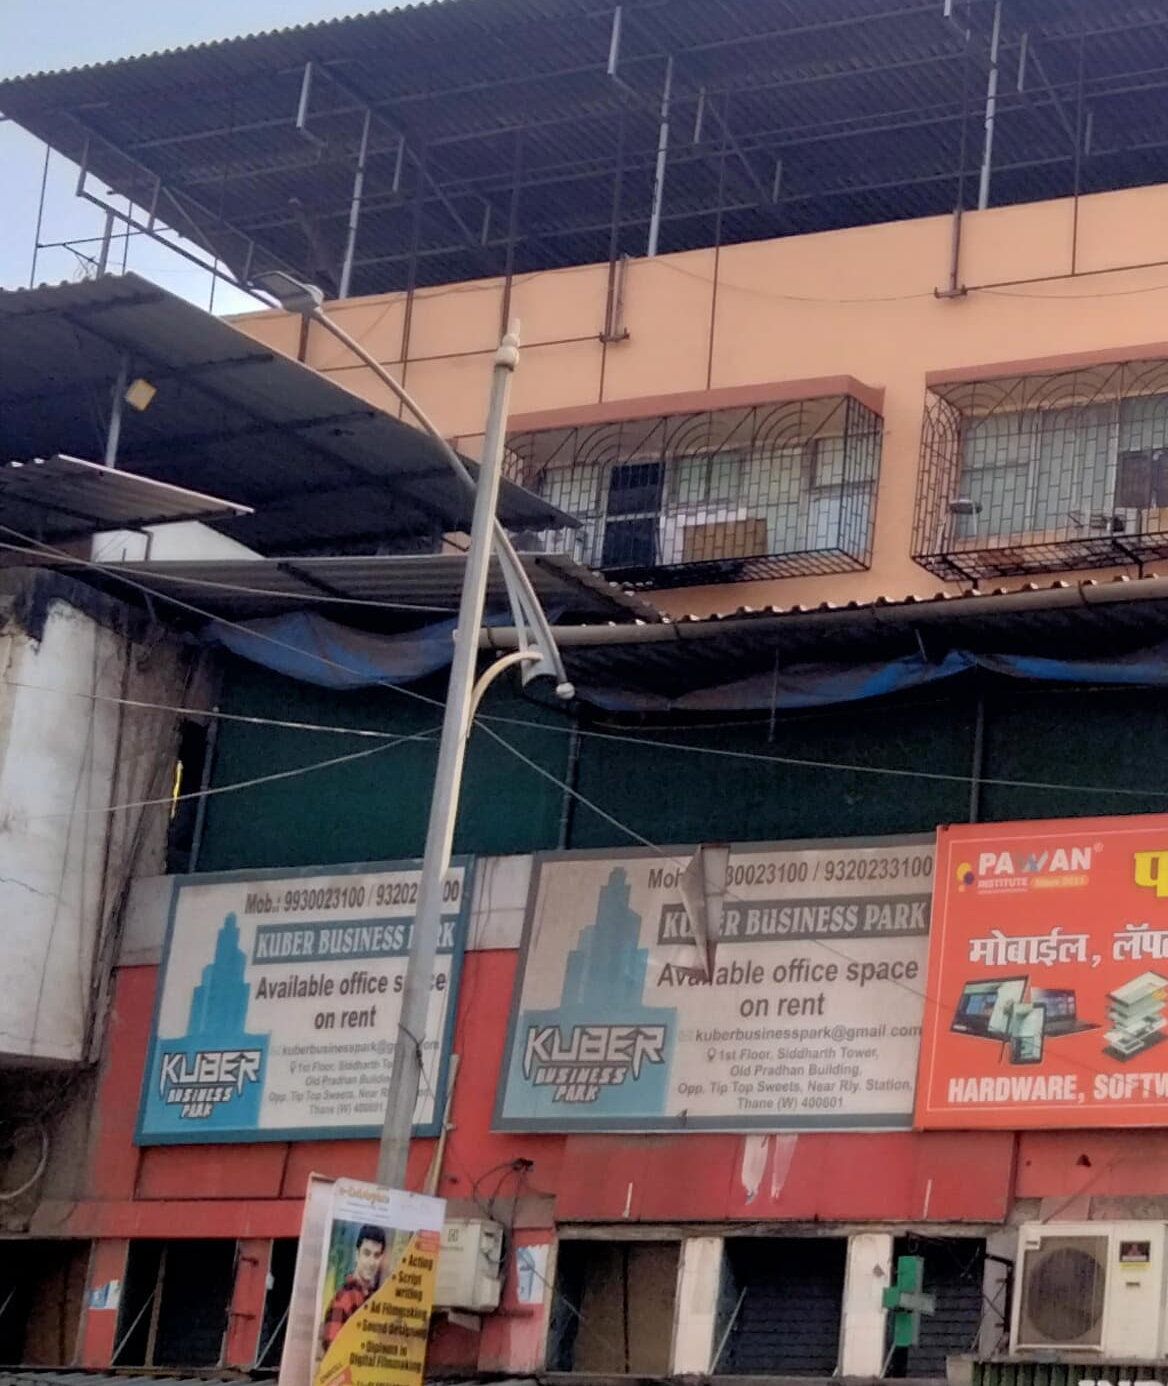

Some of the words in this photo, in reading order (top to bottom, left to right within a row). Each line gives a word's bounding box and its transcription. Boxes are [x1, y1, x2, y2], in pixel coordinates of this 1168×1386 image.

[824, 855, 934, 882] 9320233100
[979, 847, 1092, 876] PAWAN
[284, 885, 366, 912] 9930023100
[745, 903, 858, 937] BUSINESS
[864, 901, 928, 931] PARK
[256, 929, 315, 958] KUBER
[318, 925, 404, 955] BUSINESS
[255, 973, 334, 1000] Available
[339, 971, 389, 995] office
[772, 958, 838, 983] office
[846, 960, 920, 987] space
[314, 1011, 335, 1030] on
[340, 1005, 377, 1028] rent
[740, 998, 769, 1017] on
[778, 992, 826, 1016] rent
[523, 1023, 667, 1081] KUBER
[777, 1046, 837, 1060] Siddharth
[160, 1049, 262, 1098] KUBER
[532, 1066, 629, 1087] BUSINESS
[730, 1065, 751, 1077] Old
[753, 1063, 805, 1077] Pradhan
[552, 1084, 601, 1103] PARK
[710, 1082, 728, 1096] Tip
[732, 1081, 754, 1096] Top
[807, 1079, 837, 1092] Near
[948, 1074, 1086, 1104] HARDWARE,
[737, 1097, 774, 1110] Thane
[407, 1253, 434, 1271] Acting
